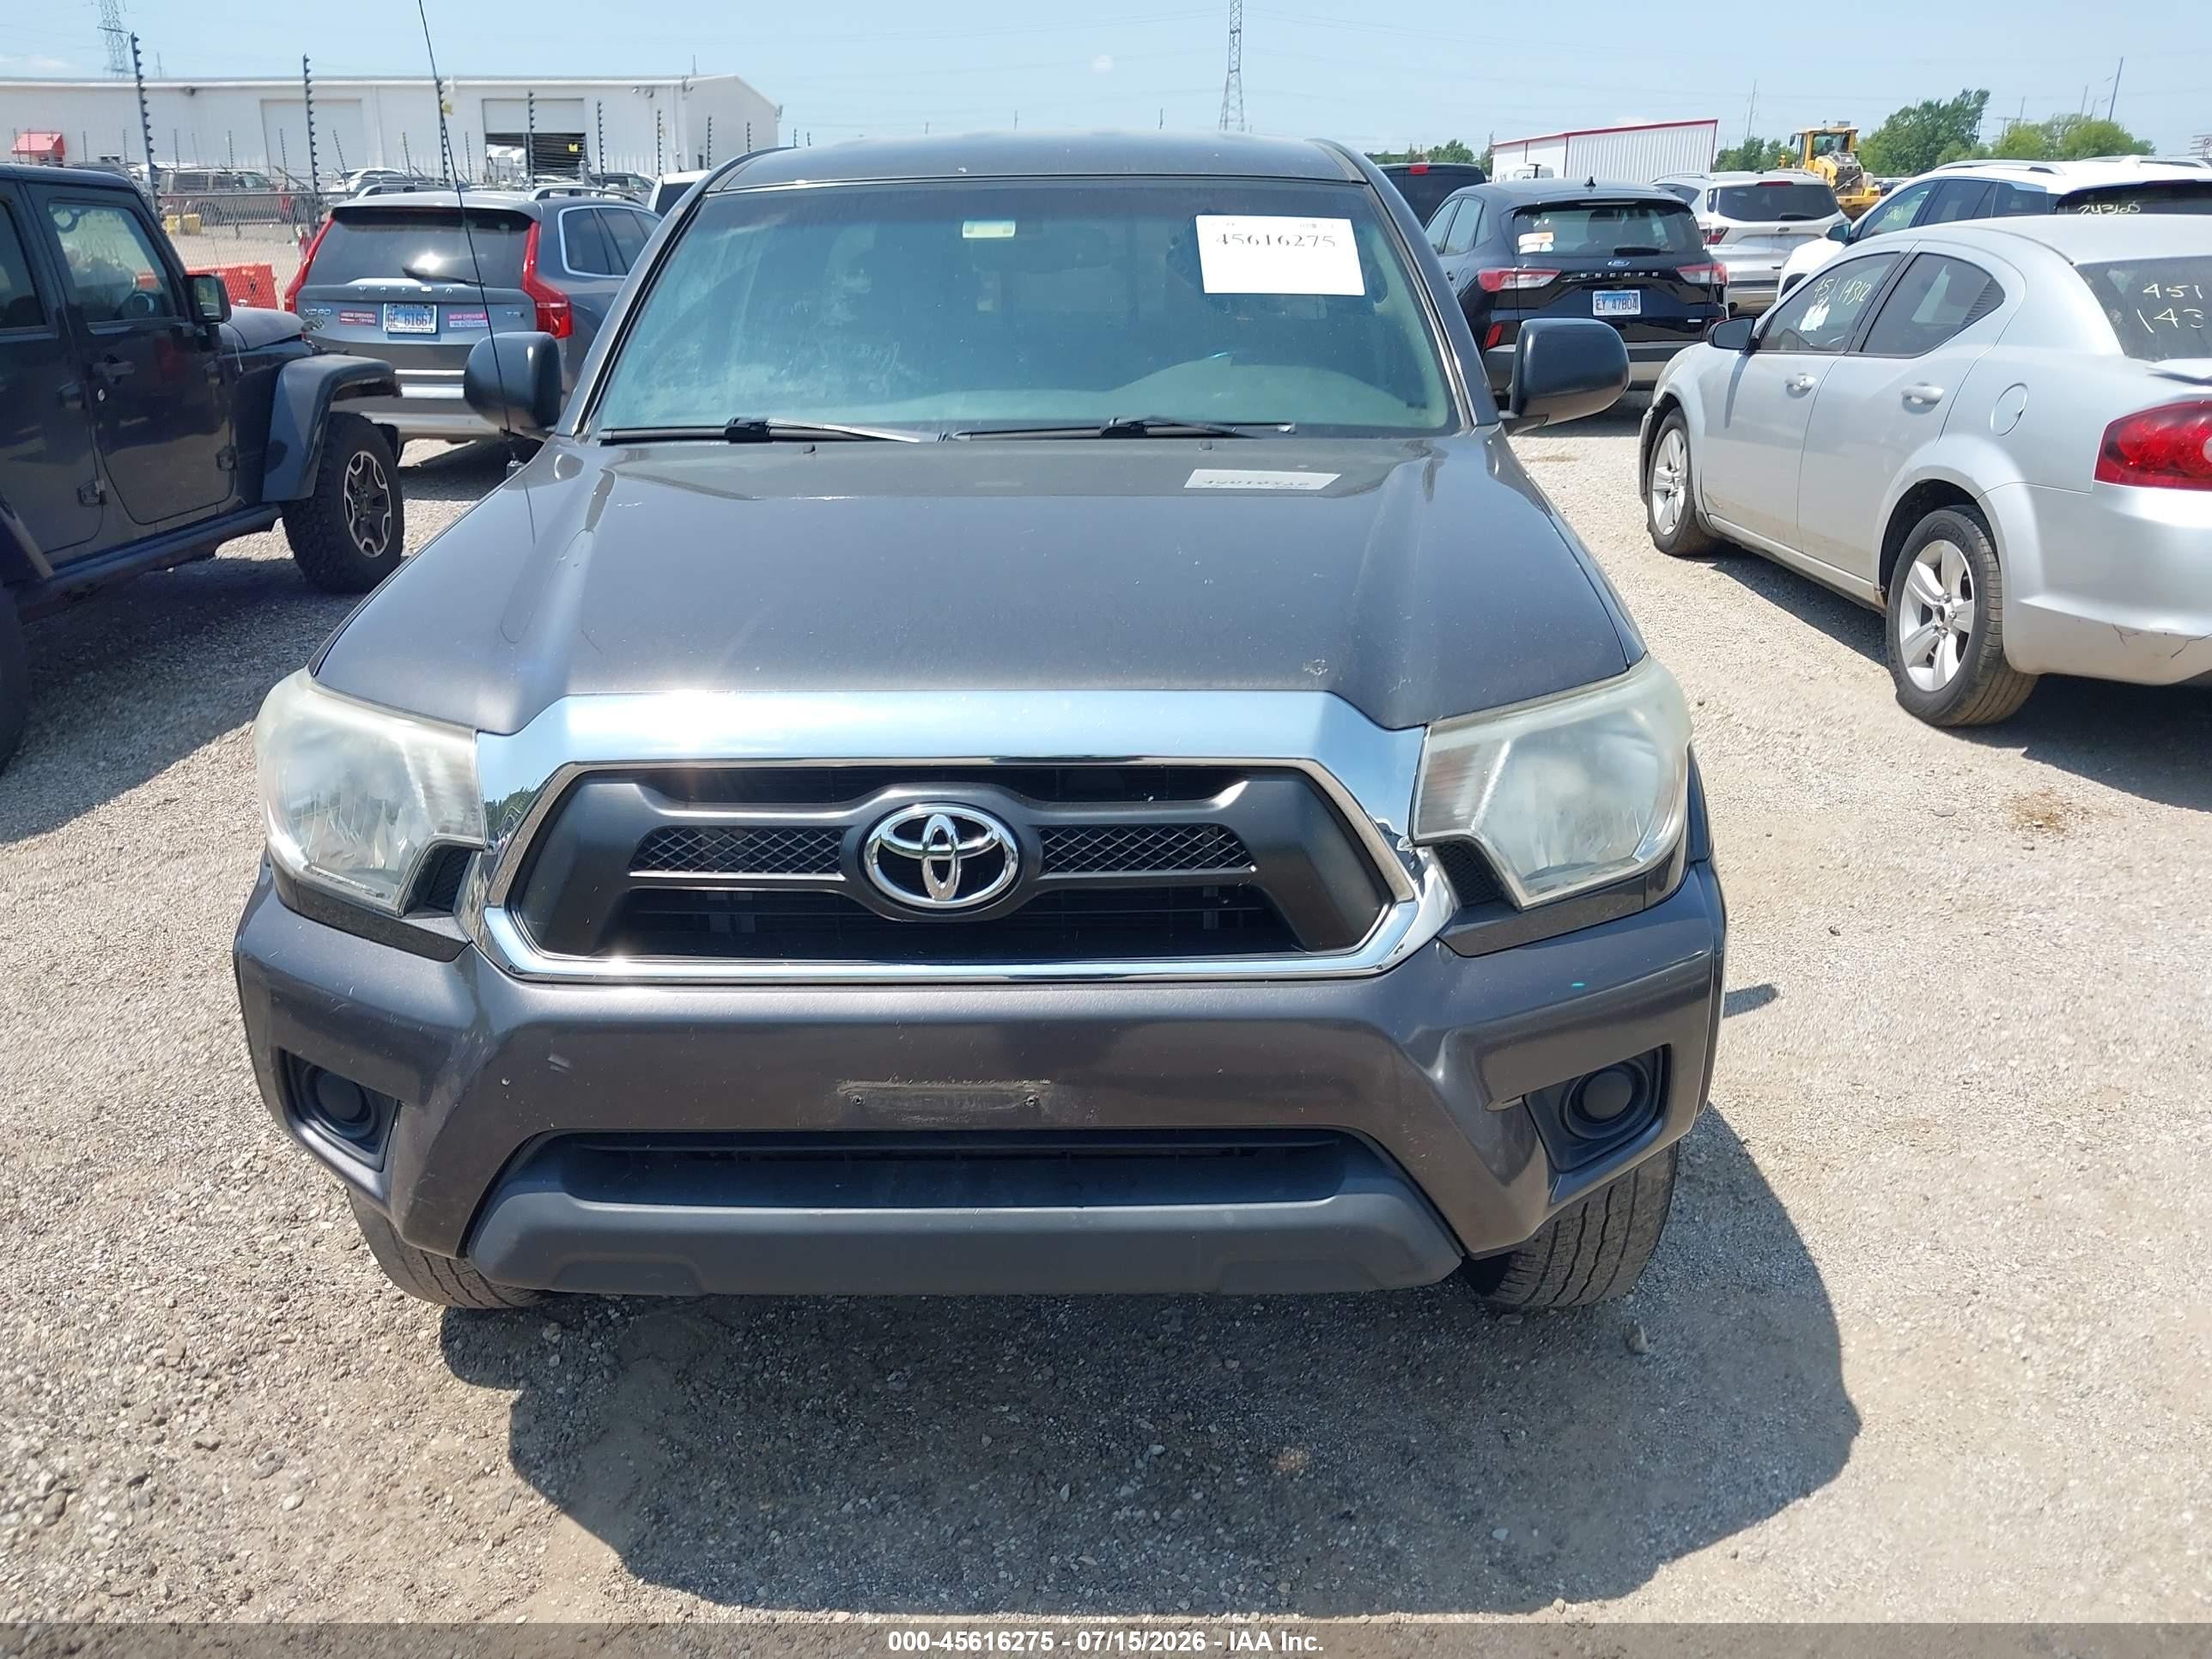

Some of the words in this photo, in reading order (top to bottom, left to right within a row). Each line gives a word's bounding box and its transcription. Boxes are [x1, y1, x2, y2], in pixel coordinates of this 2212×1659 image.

[1215, 233, 1336, 247] 45616275
[2142, 283, 2203, 300] 451
[1612, 297, 1637, 310] 47804
[404, 313, 433, 327] 61667
